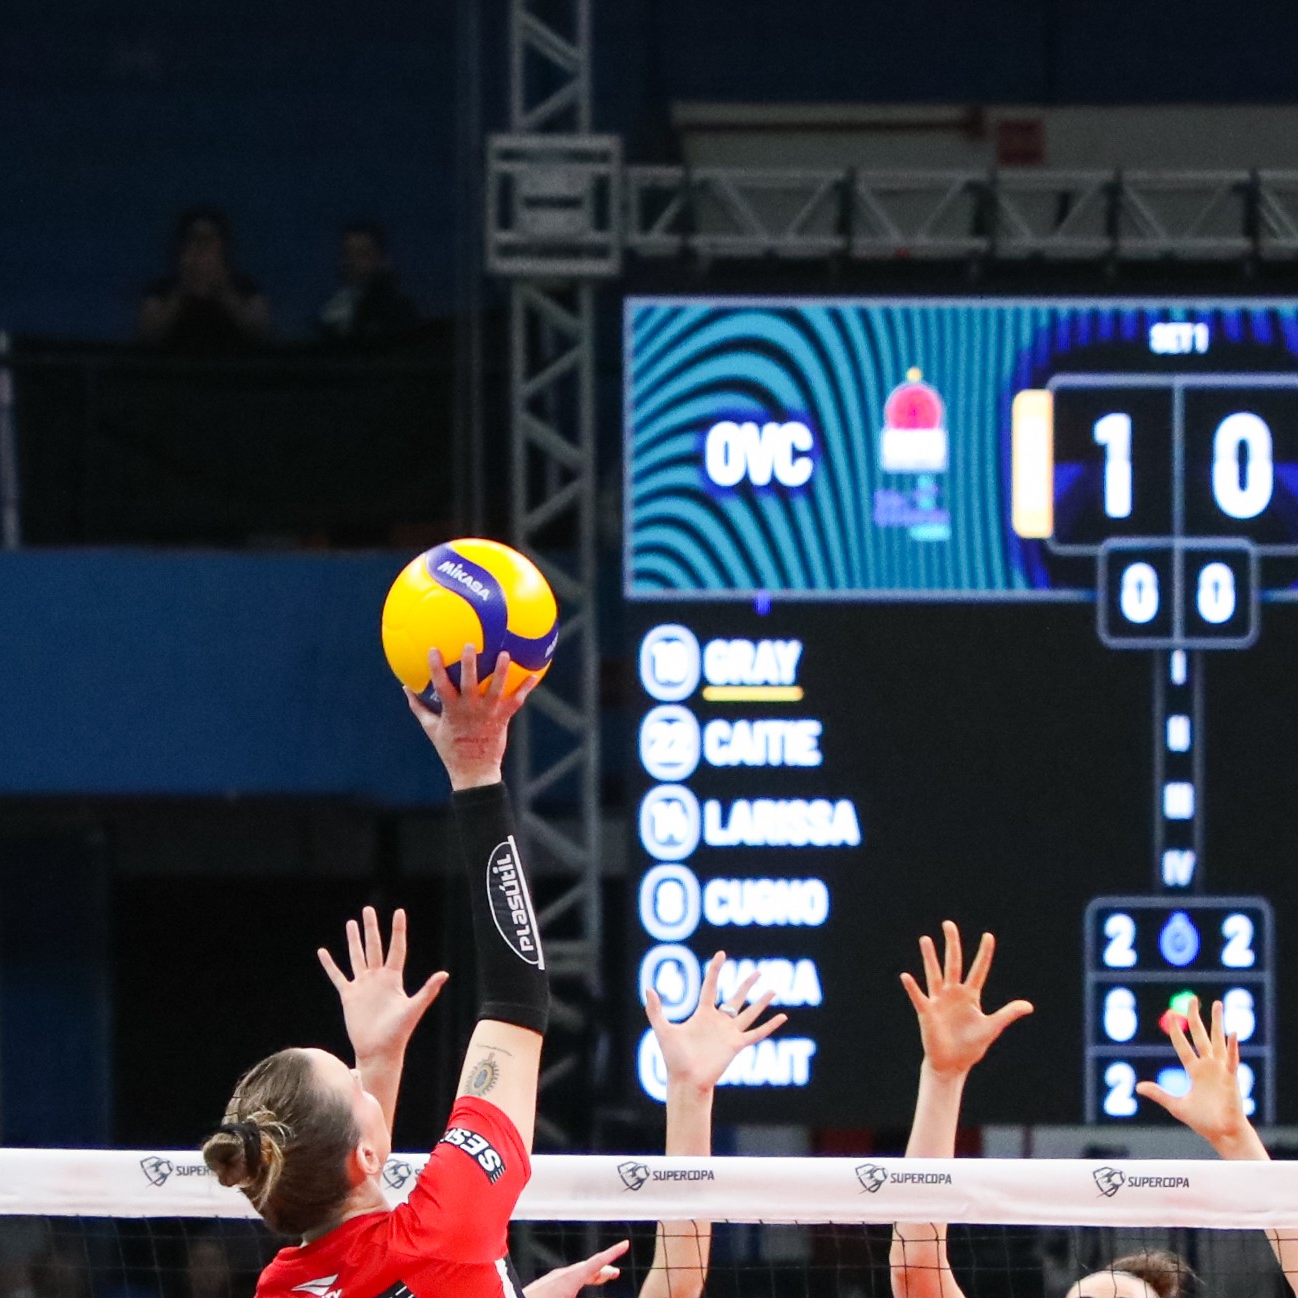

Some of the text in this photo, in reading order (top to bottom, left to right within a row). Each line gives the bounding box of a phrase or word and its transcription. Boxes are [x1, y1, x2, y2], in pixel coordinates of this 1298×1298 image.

[704, 421, 814, 487] OVC
[1094, 412, 1274, 518] 1 0
[1120, 562, 1237, 624] 0 0
[703, 639, 802, 686] GRAY
[703, 719, 823, 767] CAITIE
[703, 799, 862, 846] LARISSA
[1103, 914, 1255, 968] 2 2
[714, 1038, 817, 1086] RAIT
[1104, 1061, 1137, 1116] 2
[652, 1170, 715, 1182] SUPERCOPA
[890, 1172, 953, 1185] SUPERCOPA
[1127, 1176, 1190, 1189] SUPERCOPA
